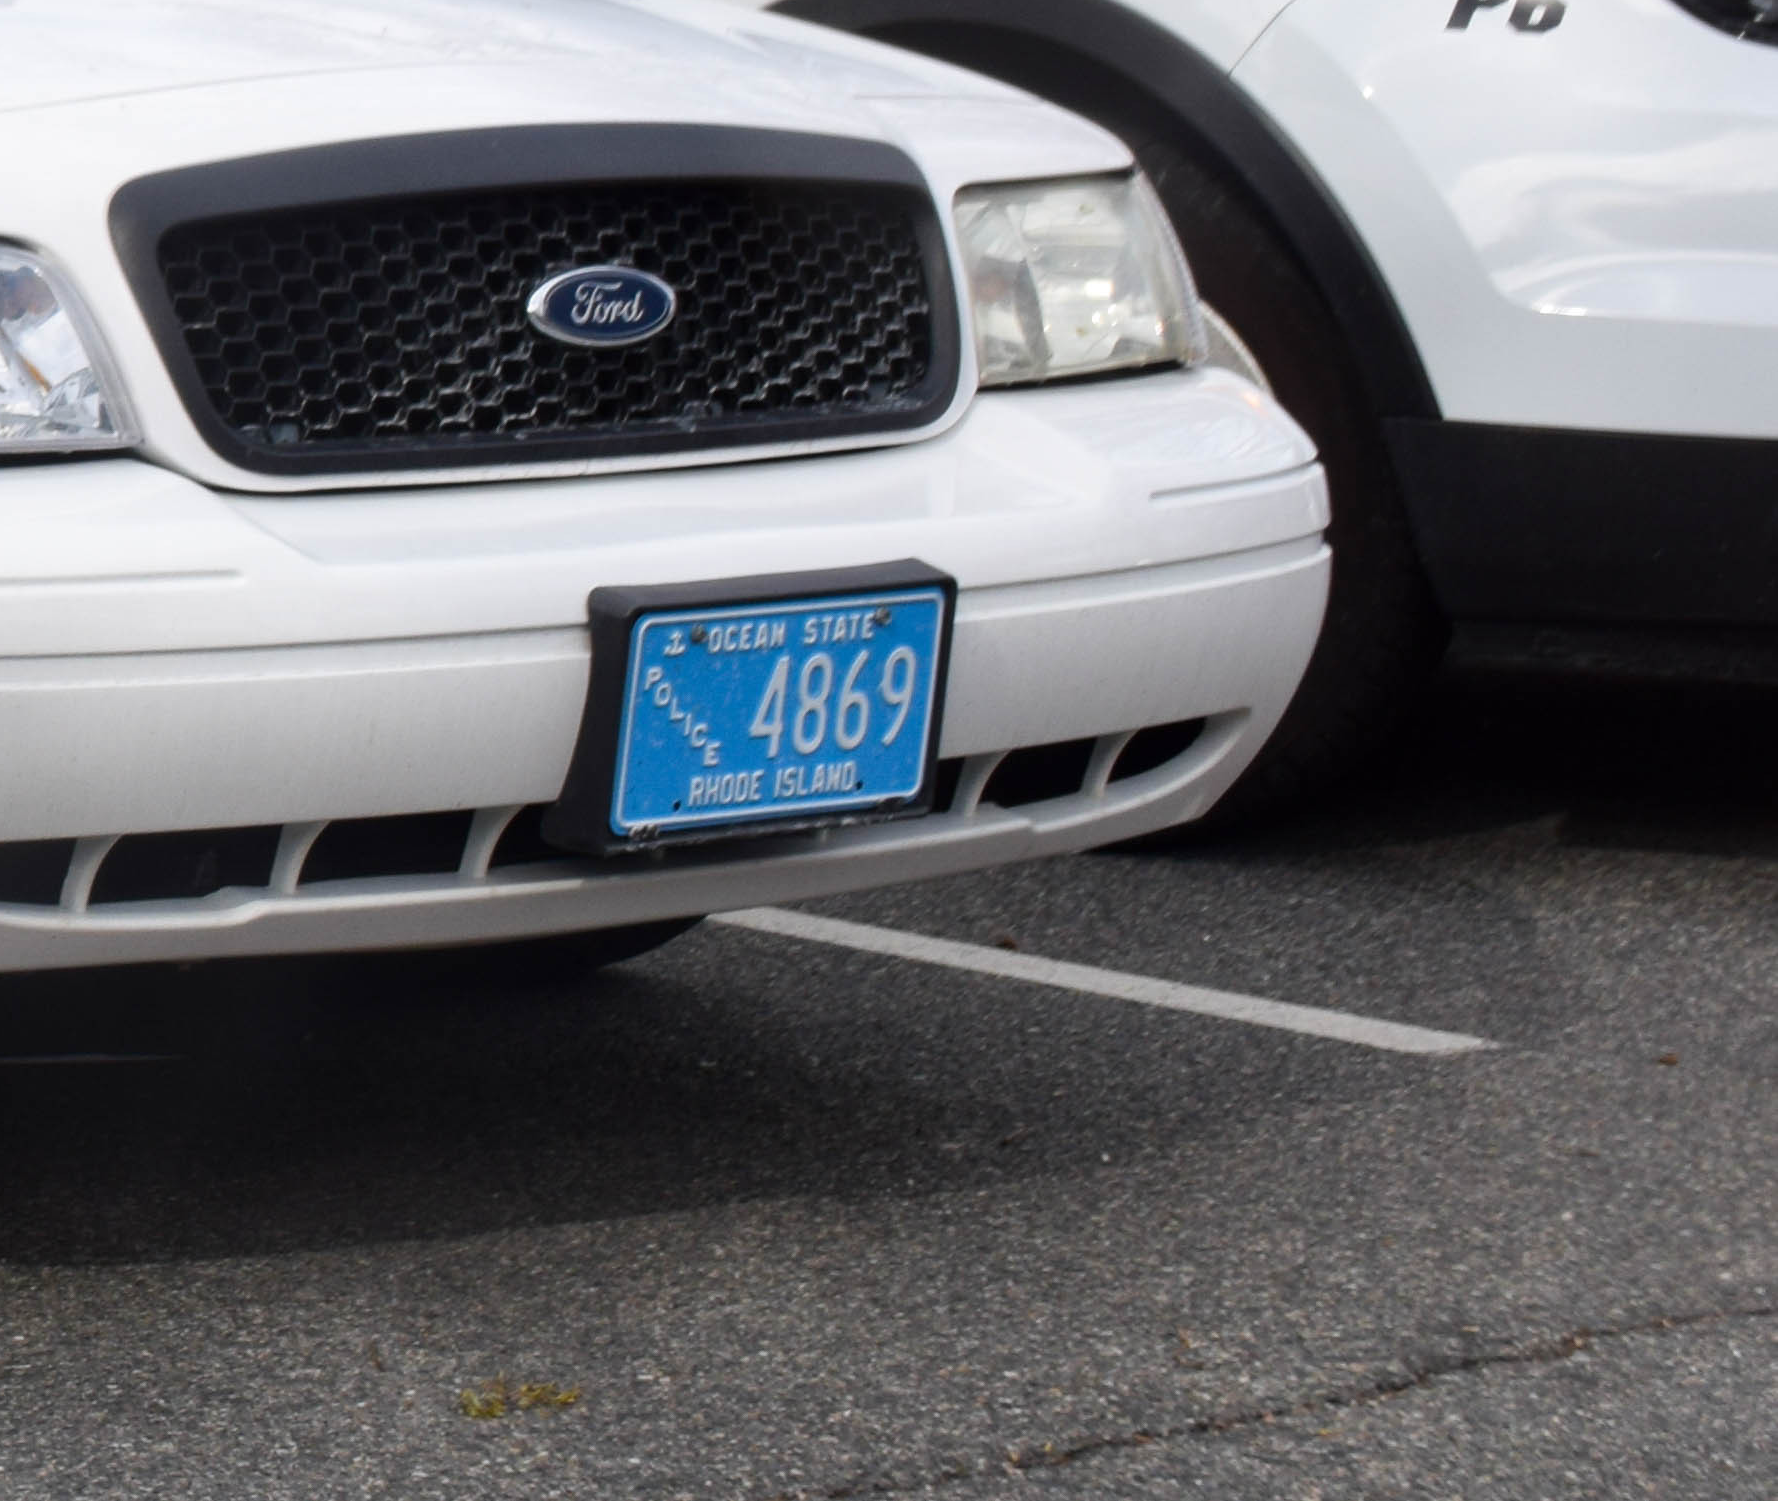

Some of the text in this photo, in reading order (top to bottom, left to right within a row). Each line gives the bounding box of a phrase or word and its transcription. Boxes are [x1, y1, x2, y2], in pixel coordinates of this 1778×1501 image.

[570, 281, 645, 325] Ford
[706, 615, 875, 655] OCEAN STATE
[643, 665, 723, 768] POLICE
[748, 645, 917, 760] 4869
[687, 760, 859, 809] RHODE ISLAND
